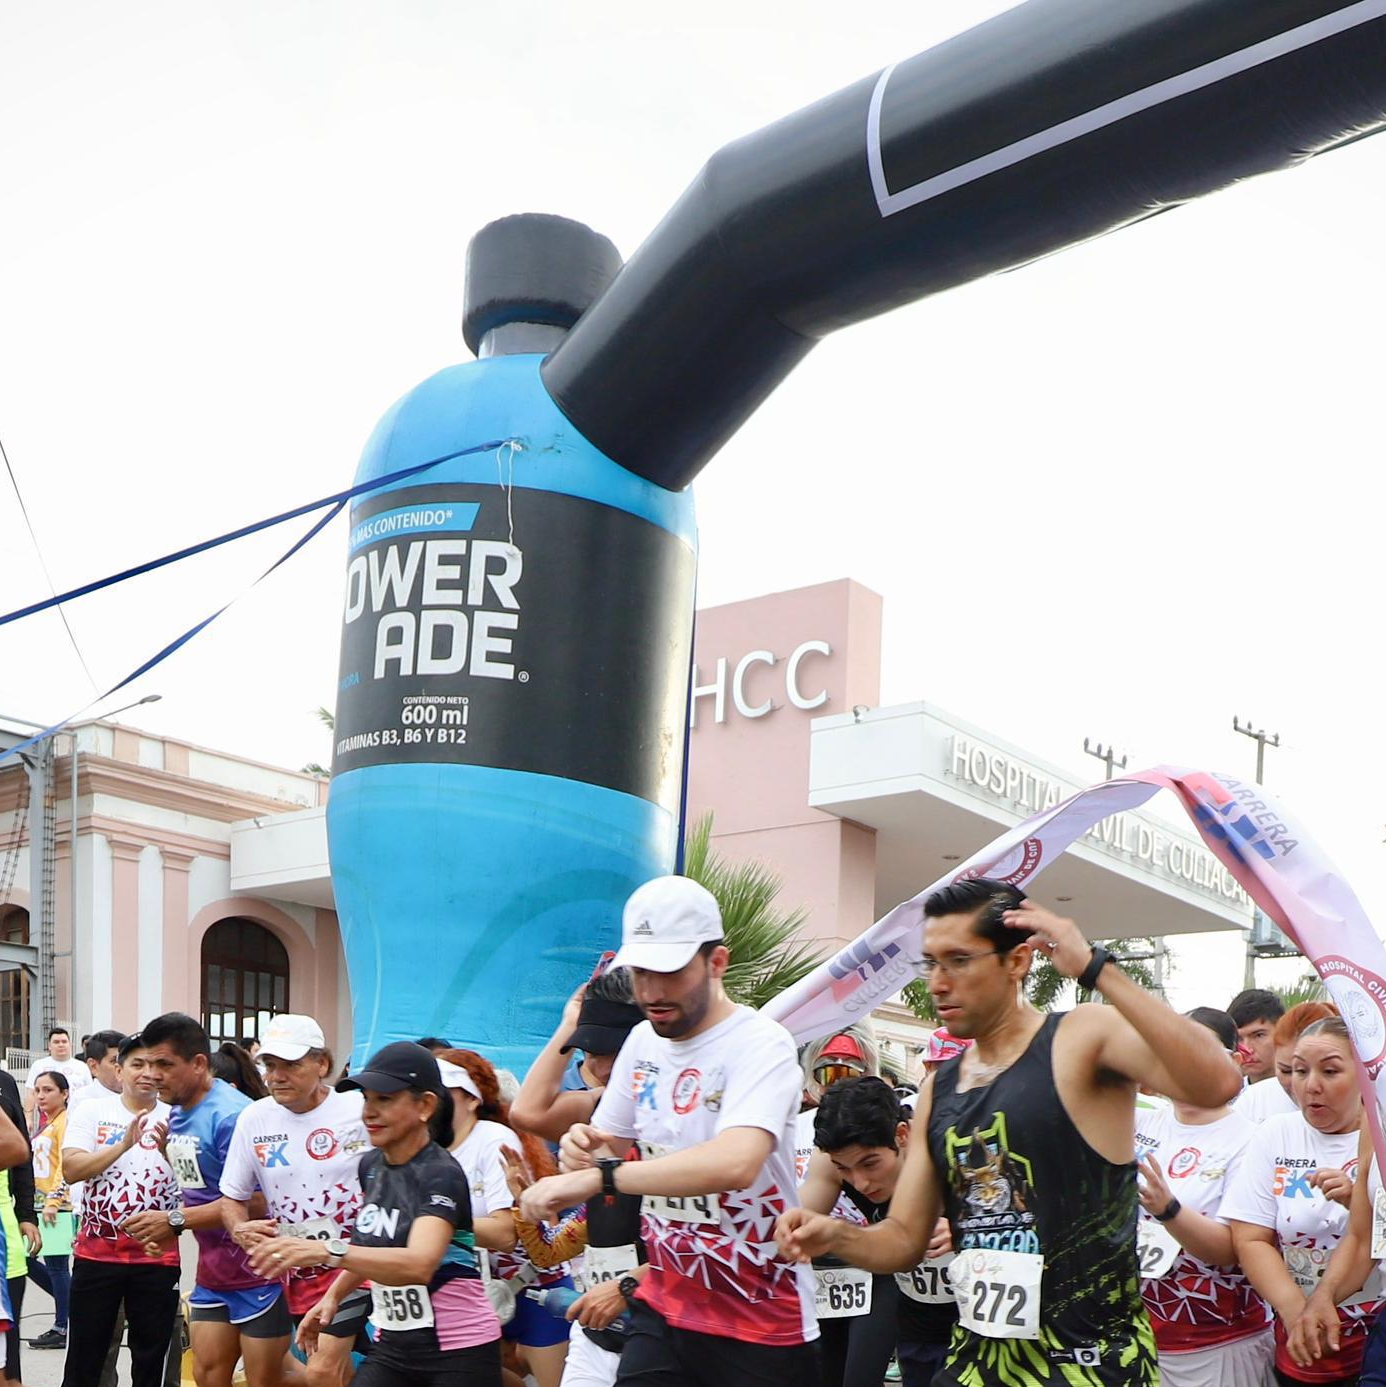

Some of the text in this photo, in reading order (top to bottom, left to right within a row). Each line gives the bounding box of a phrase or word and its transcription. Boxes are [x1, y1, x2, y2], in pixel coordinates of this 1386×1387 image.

[689, 640, 831, 729] HCC
[402, 695, 470, 705] CONTENIDO NETO
[401, 704, 469, 725] 600 ml
[336, 728, 467, 756] VITAMINAS B3, B6 Y B12
[1211, 772, 1299, 857] CARRERA
[1084, 812, 1133, 853] IVIL
[1136, 824, 1164, 866] DE
[1319, 960, 1365, 984] HOSPITAL
[253, 1133, 289, 1144] CARRERA
[253, 1141, 291, 1168] 5K
[829, 1282, 867, 1310] 635
[973, 1280, 1028, 1326] 272
